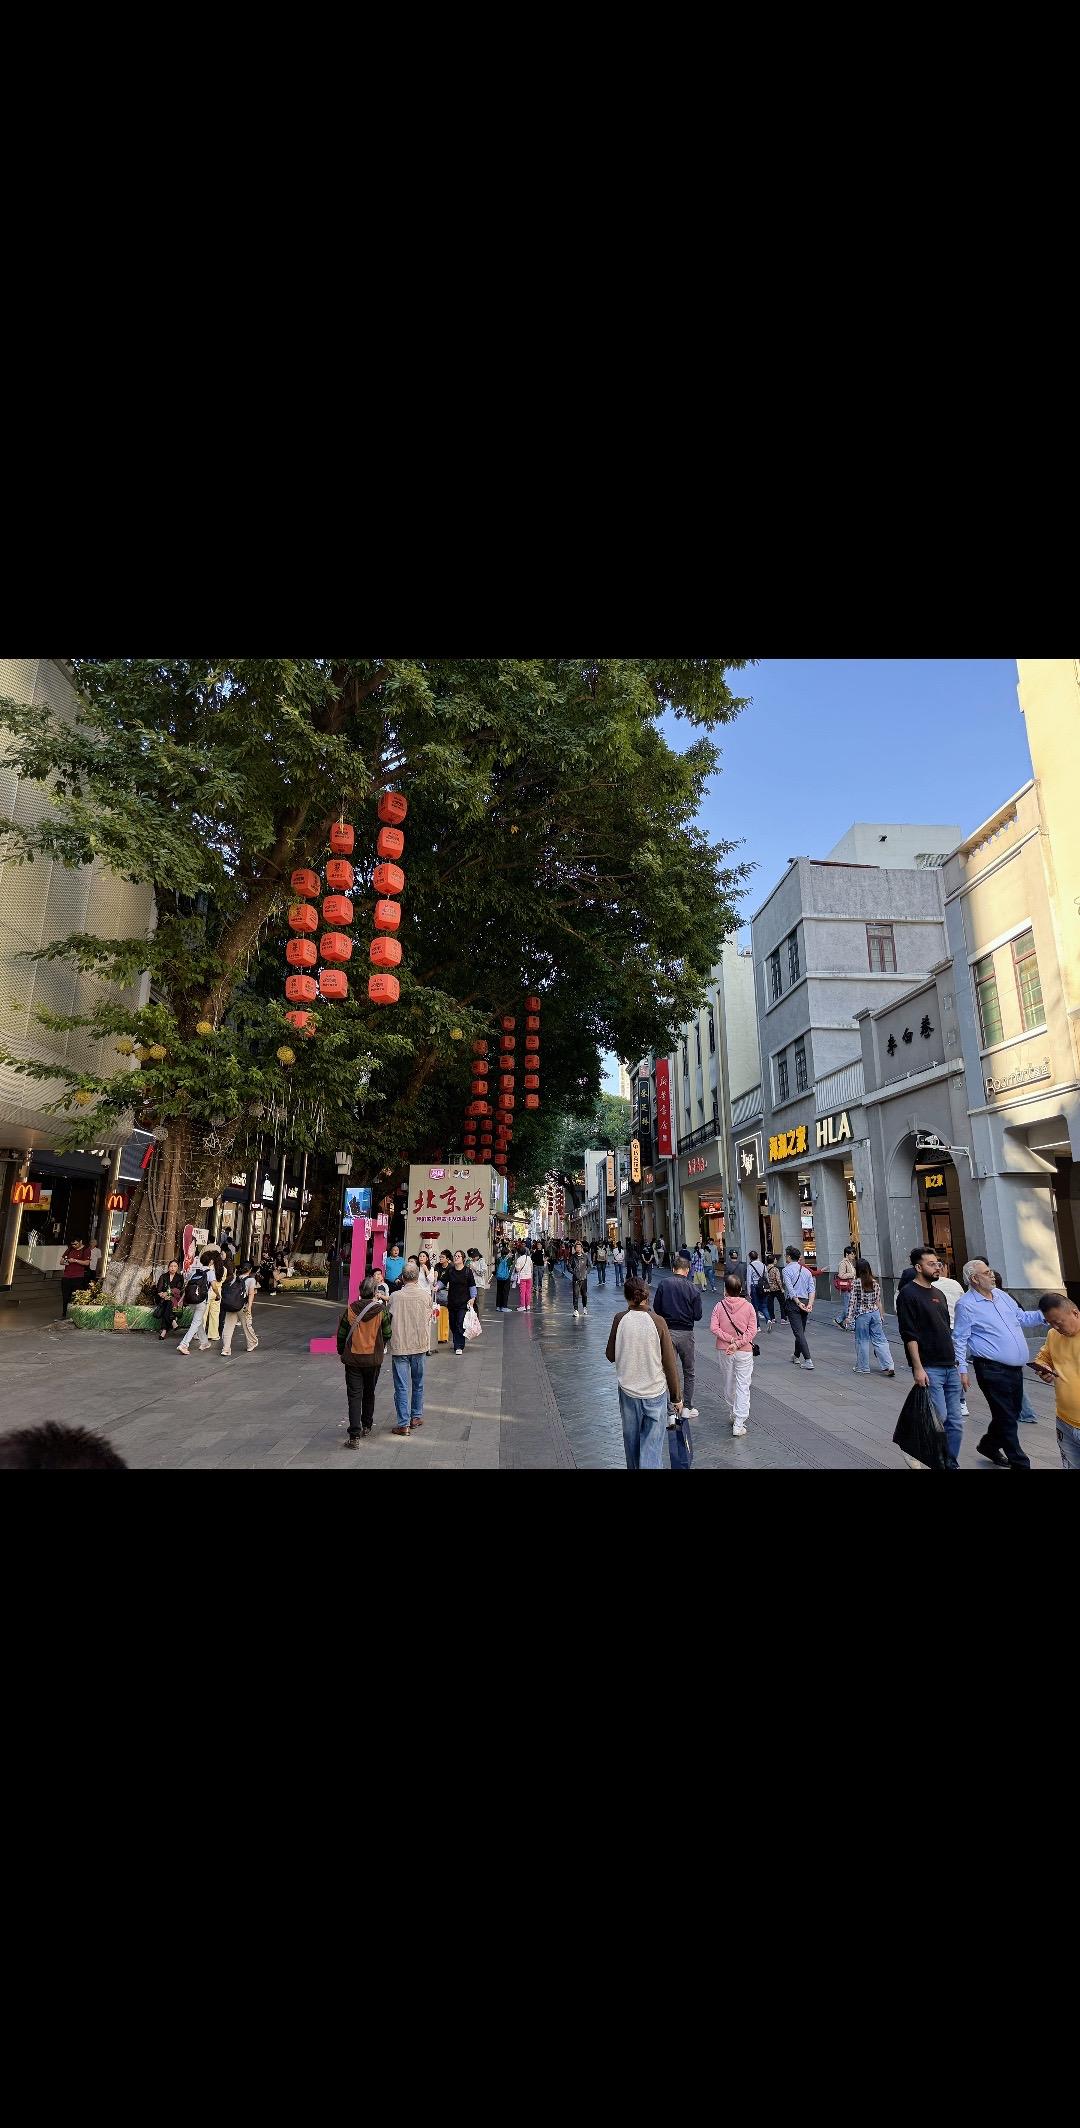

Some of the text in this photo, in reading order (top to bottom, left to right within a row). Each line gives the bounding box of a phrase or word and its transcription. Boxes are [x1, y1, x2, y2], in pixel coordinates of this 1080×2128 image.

[768, 1125, 807, 1162] 海澜之家
[815, 1111, 852, 1148] HLA
[412, 1185, 485, 1215] 北京路
